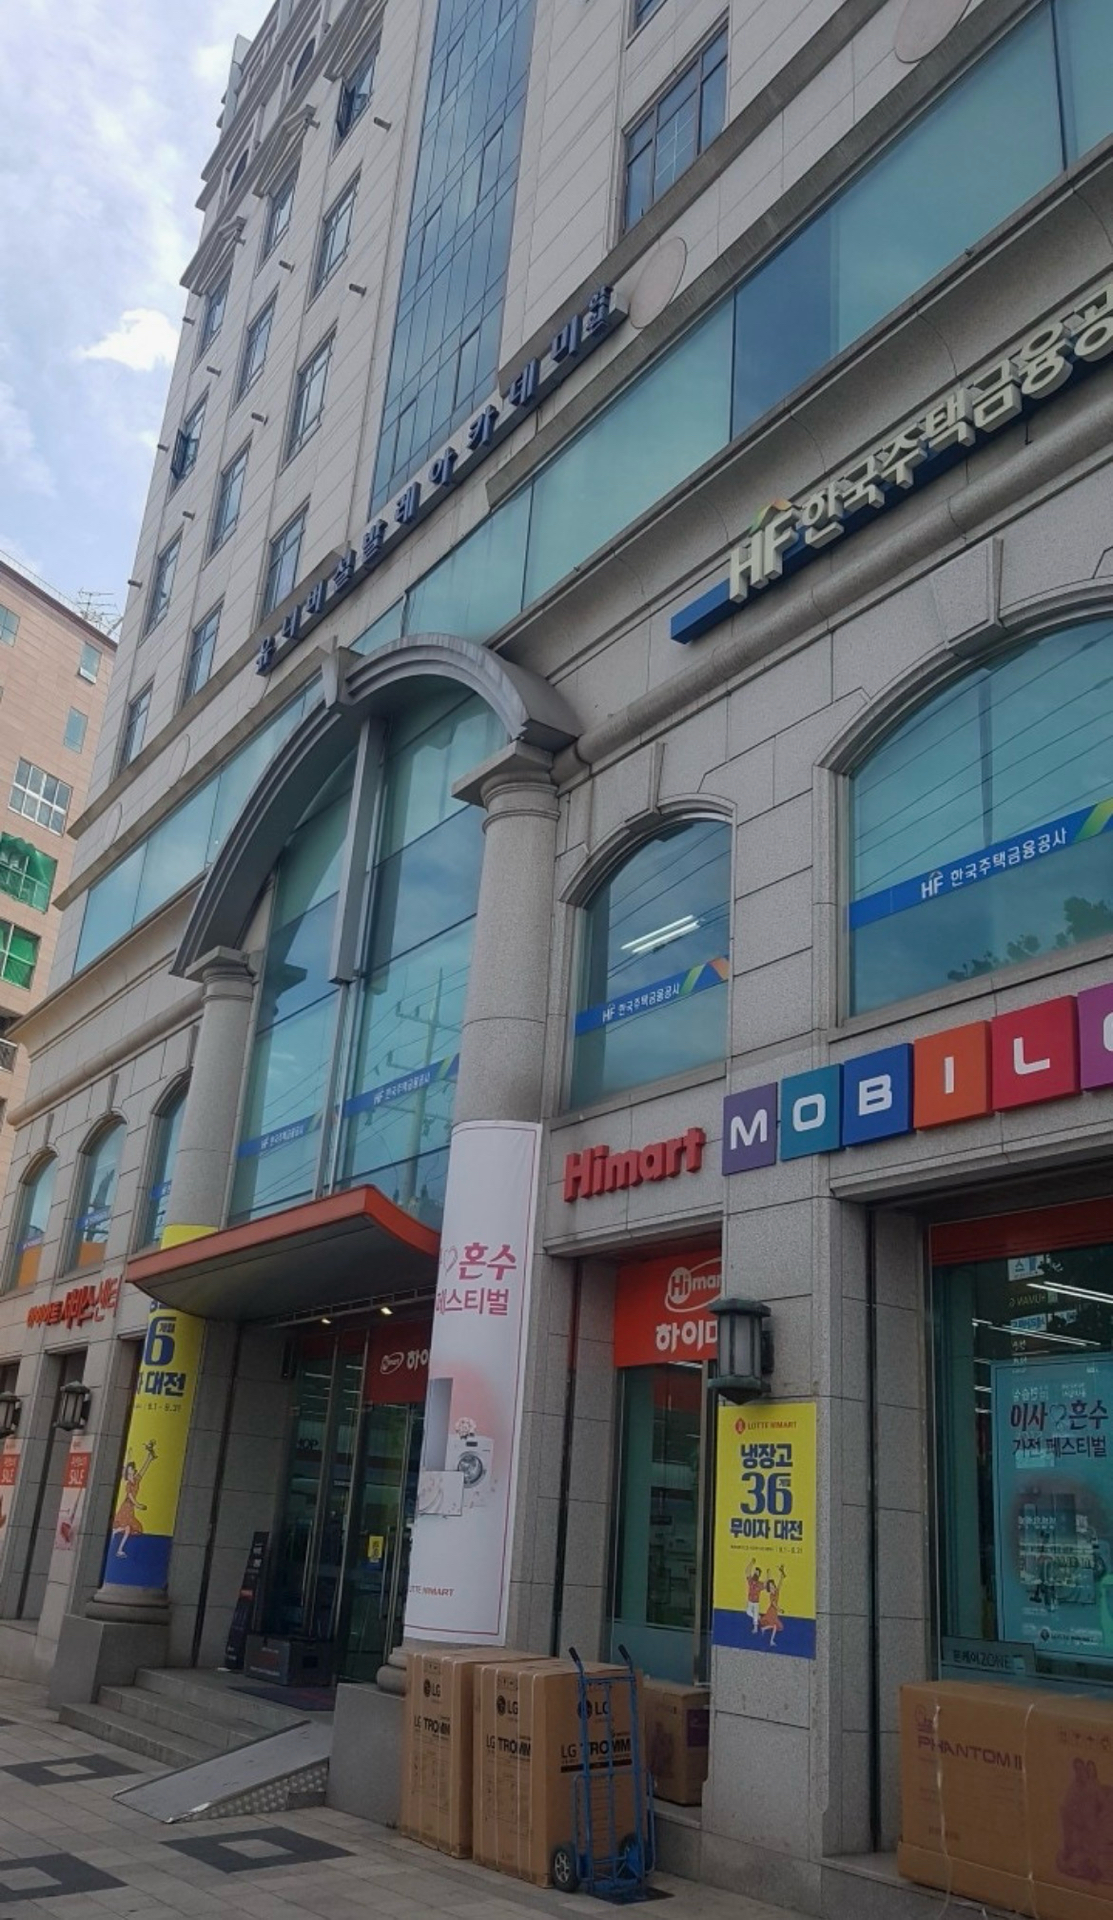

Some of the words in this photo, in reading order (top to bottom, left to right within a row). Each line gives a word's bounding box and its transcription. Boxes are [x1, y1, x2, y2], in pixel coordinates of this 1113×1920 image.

[729, 509, 802, 604] HF
[921, 873, 944, 899] HF
[950, 827, 1067, 887] 한국주택금융공사
[618, 983, 680, 1017] 한국주택금융공사
[564, 1126, 707, 1203] Himart
[459, 1242, 517, 1280] 혼수
[1010, 1402, 1048, 1431] 이사
[1068, 1400, 1109, 1430] 혼수
[741, 1443, 793, 1469] 냉장고
[740, 1471, 793, 1516] 36
[730, 1517, 770, 1539] 무이자
[774, 1519, 803, 1541] 대전
[507, 1700, 518, 1715] LG
[561, 1743, 577, 1759] LG
[917, 1735, 1010, 1769] PHANTOM
